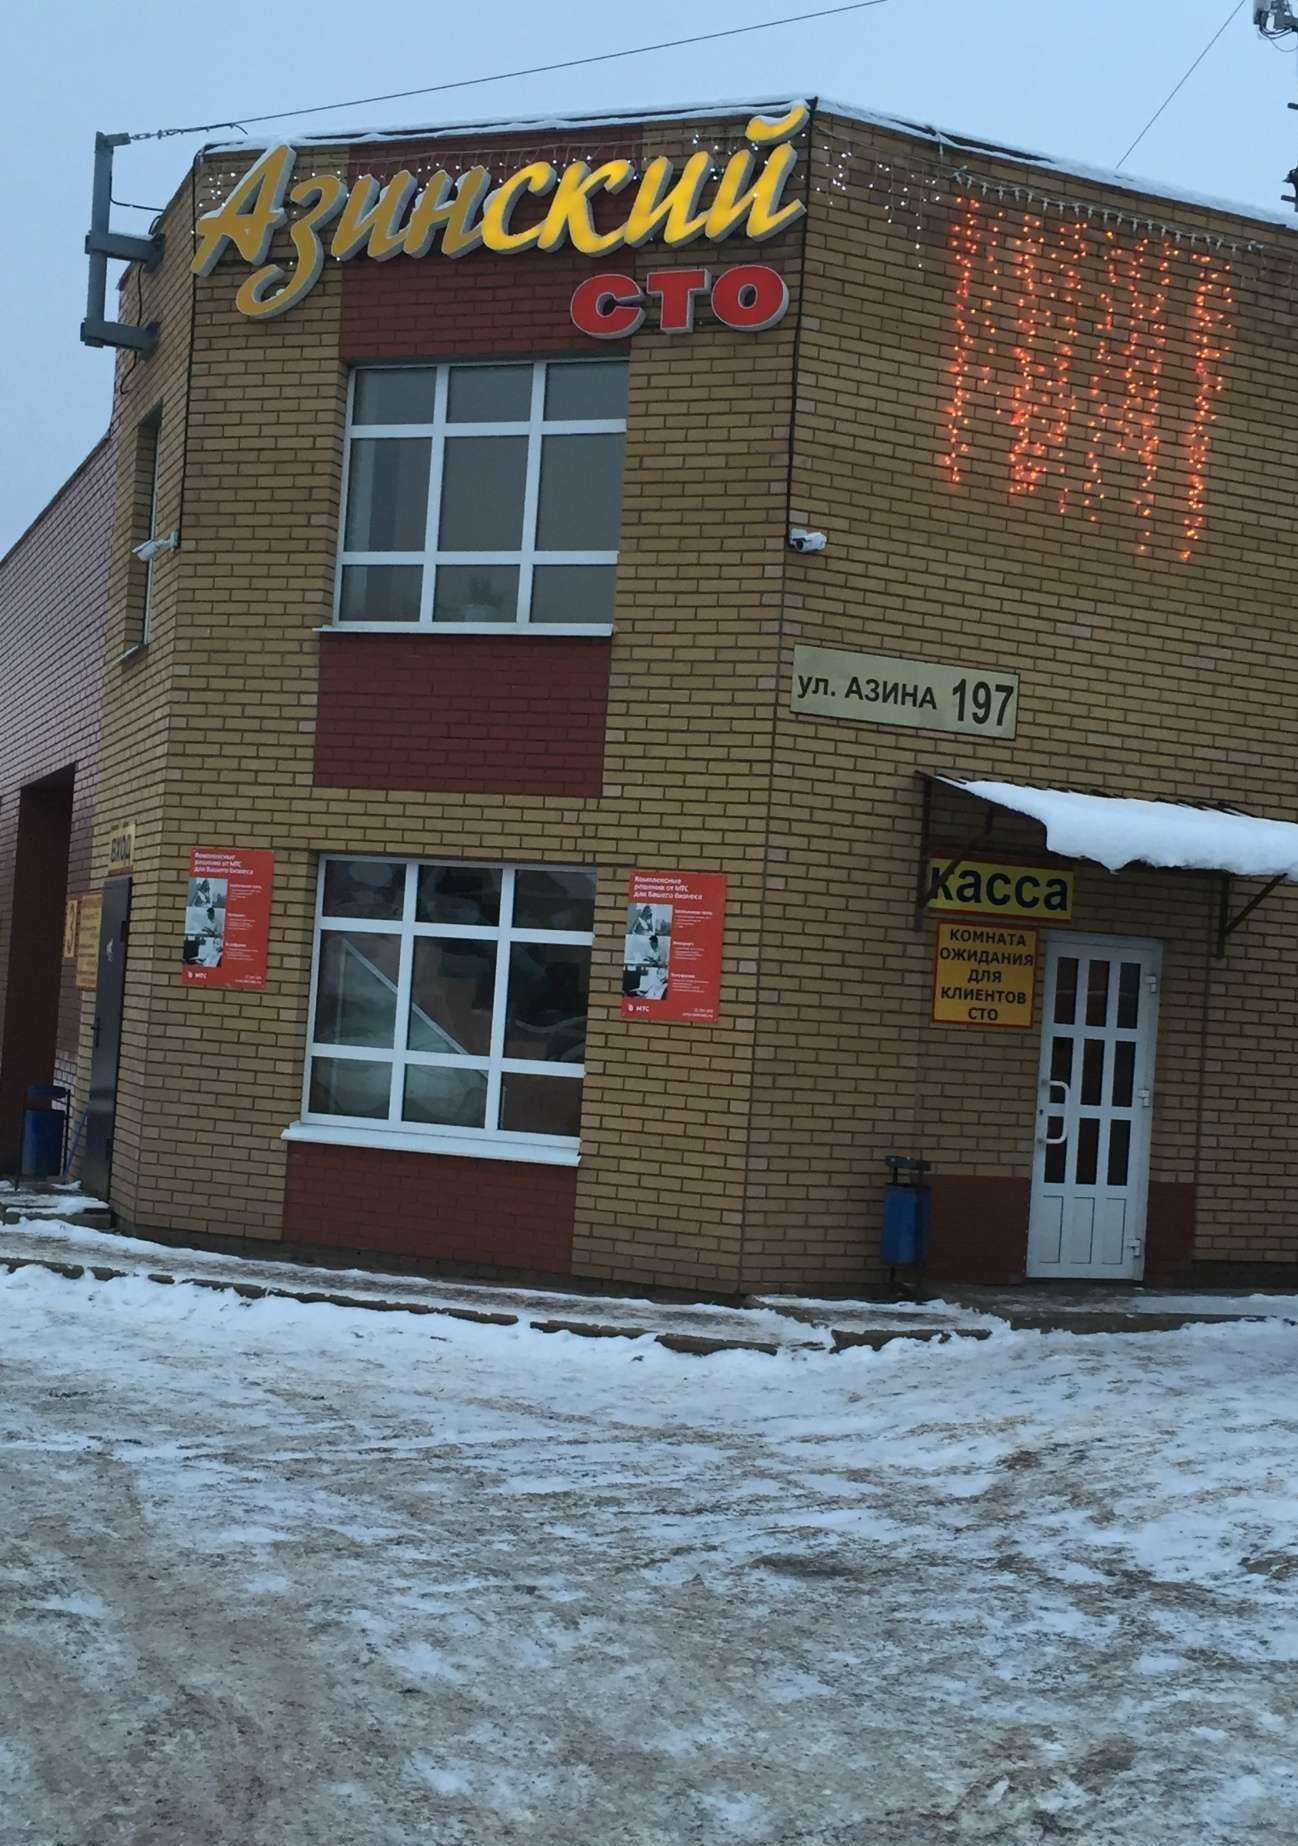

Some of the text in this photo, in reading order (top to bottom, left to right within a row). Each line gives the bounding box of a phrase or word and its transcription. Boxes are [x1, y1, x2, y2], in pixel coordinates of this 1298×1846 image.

[191, 105, 809, 319] Азинский
[570, 264, 790, 339] СТО
[797, 675, 1015, 727] ул. АЗИНА 197
[950, 929, 1026, 947] КОМНАТА
[940, 947, 1034, 966] ОЖИДАНИЯ
[967, 969, 1002, 983] ДЛЯ
[941, 987, 1026, 1005] КЛИЕНТОВ
[968, 1007, 998, 1021] СТО
